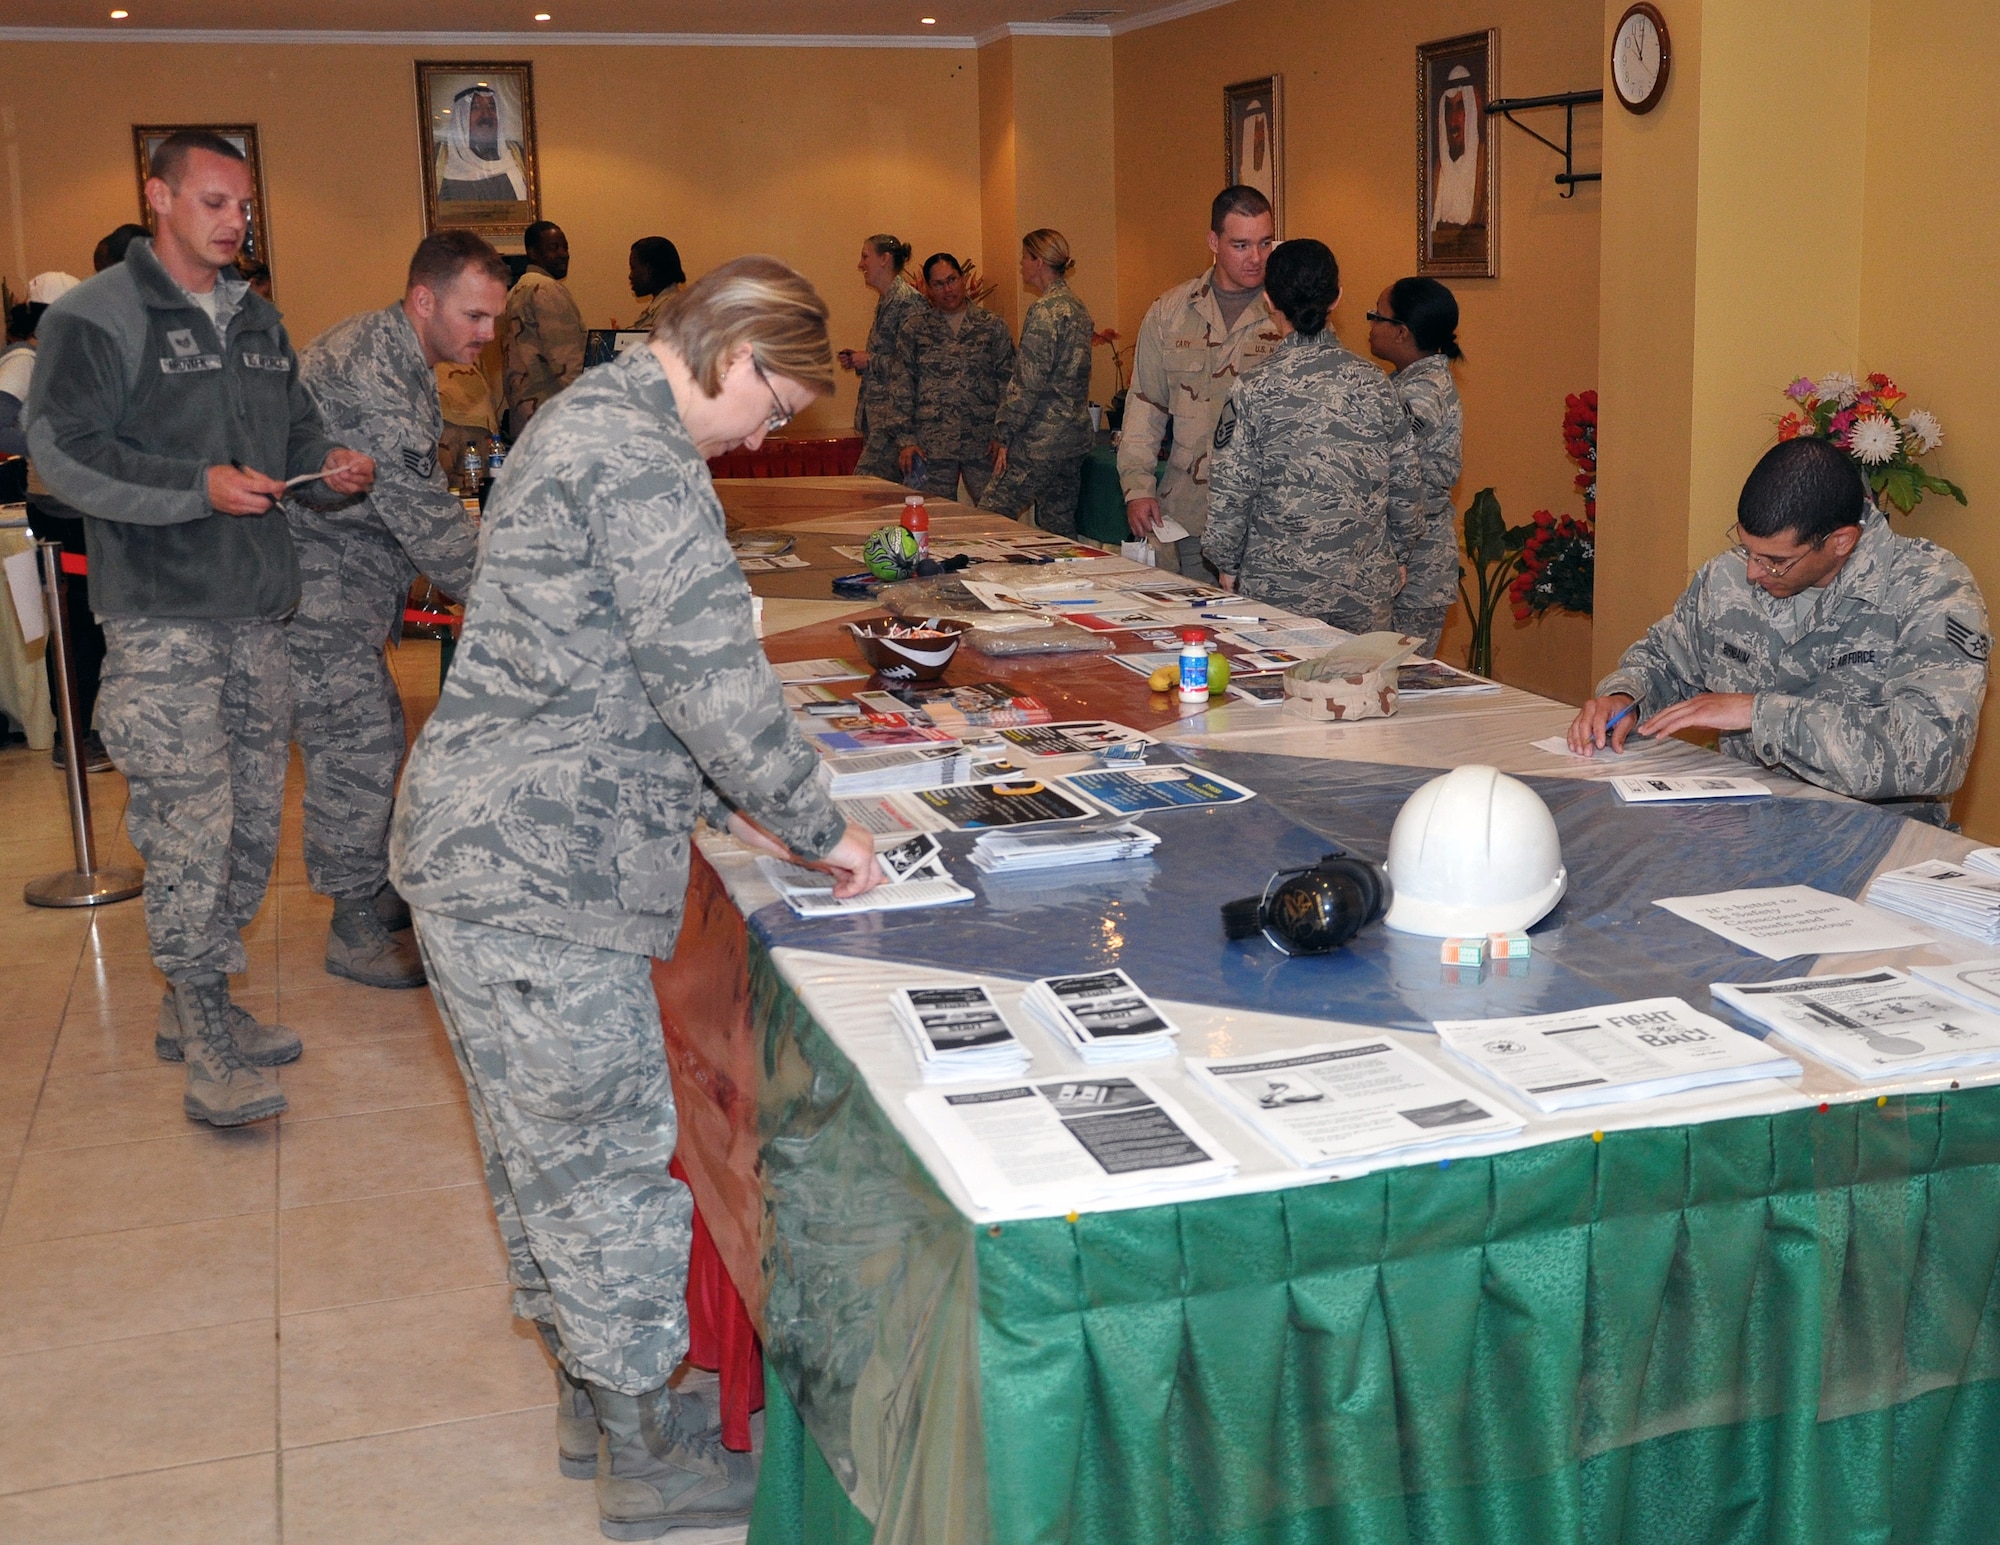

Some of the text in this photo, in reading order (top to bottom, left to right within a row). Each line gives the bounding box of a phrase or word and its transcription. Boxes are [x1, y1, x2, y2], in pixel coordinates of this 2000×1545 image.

[1175, 340, 1191, 349] CARY
[1848, 650, 1876, 665] FORCE
[1733, 899, 1778, 910] better
[1780, 897, 1798, 905] to
[1723, 905, 1841, 926] Conscious than
[1735, 916, 1826, 932] Unsafe and
[1605, 1010, 1679, 1028] FIGHT
[1636, 1027, 1718, 1048] BAC!
